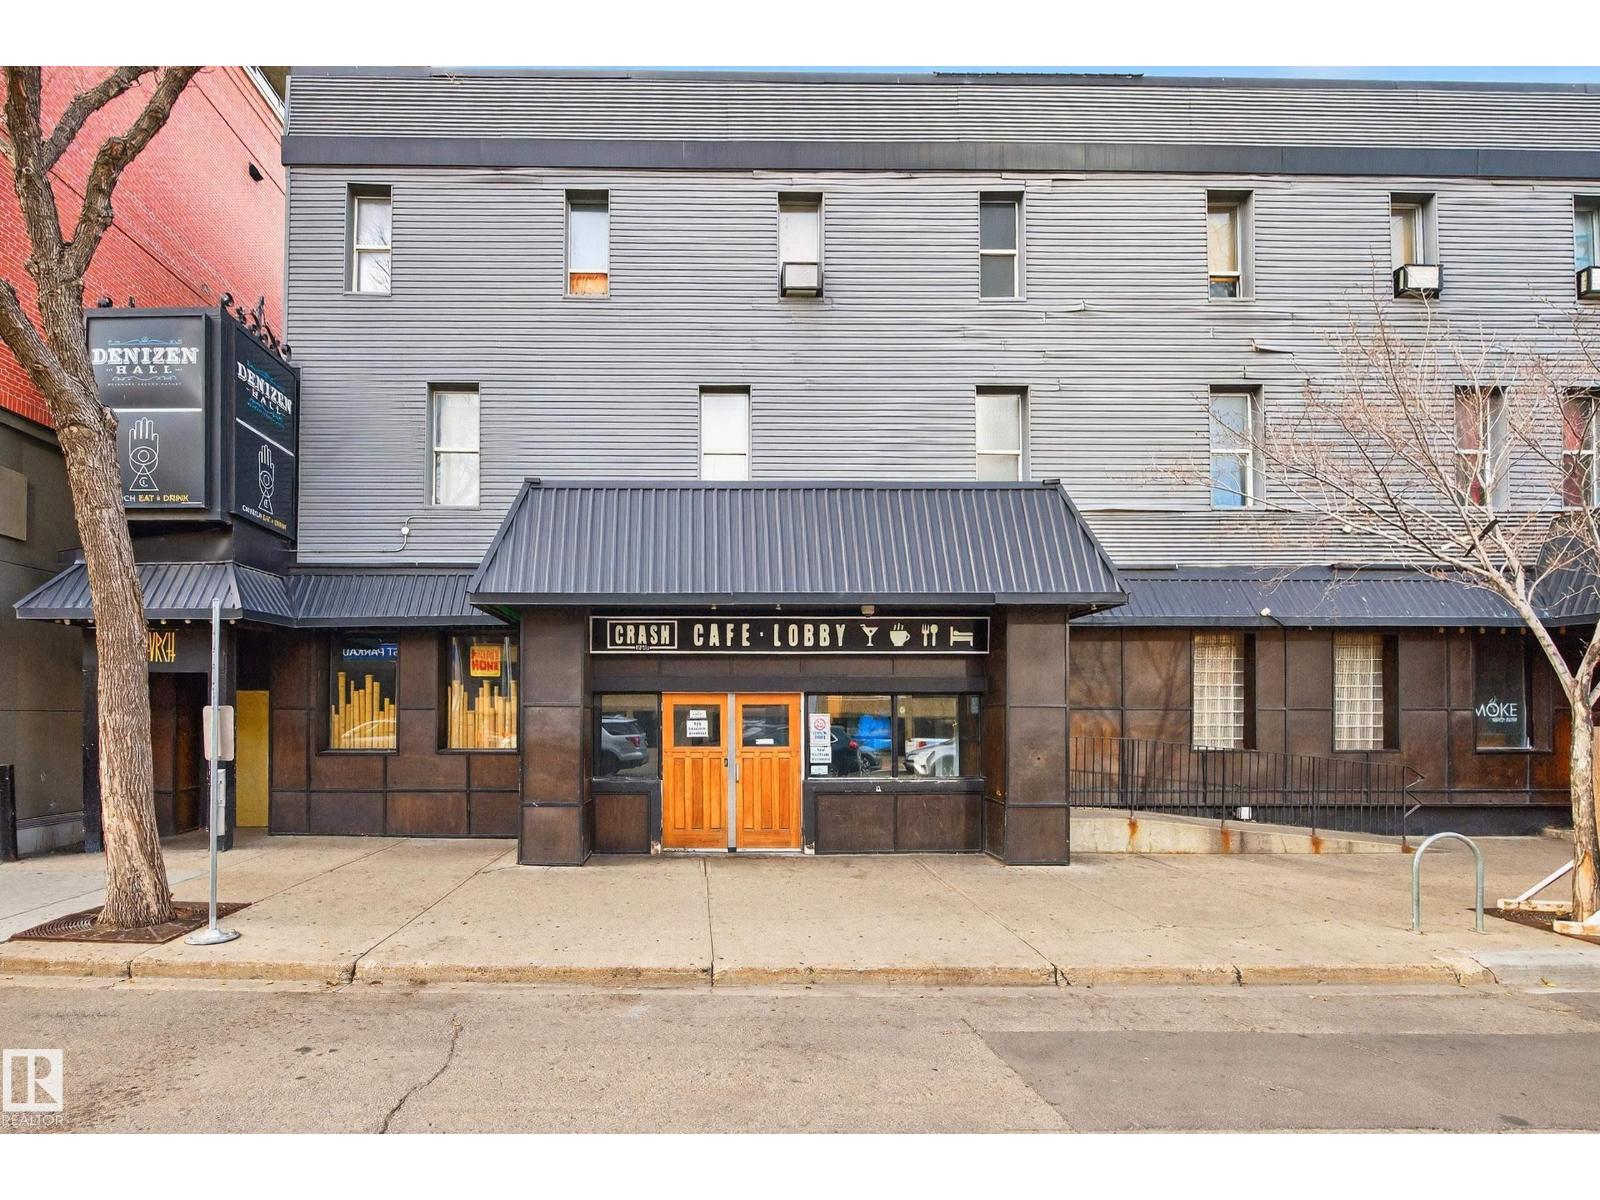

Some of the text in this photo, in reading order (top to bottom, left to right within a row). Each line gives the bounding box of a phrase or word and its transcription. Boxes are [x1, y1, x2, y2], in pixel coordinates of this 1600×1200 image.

[92, 347, 199, 365] DENIZEN
[116, 365, 172, 374] HALL
[237, 361, 292, 415] DENIZEN
[163, 494, 189, 502] DRINK
[615, 624, 670, 645] CRASH
[693, 623, 846, 647] CAFE LOBBY
